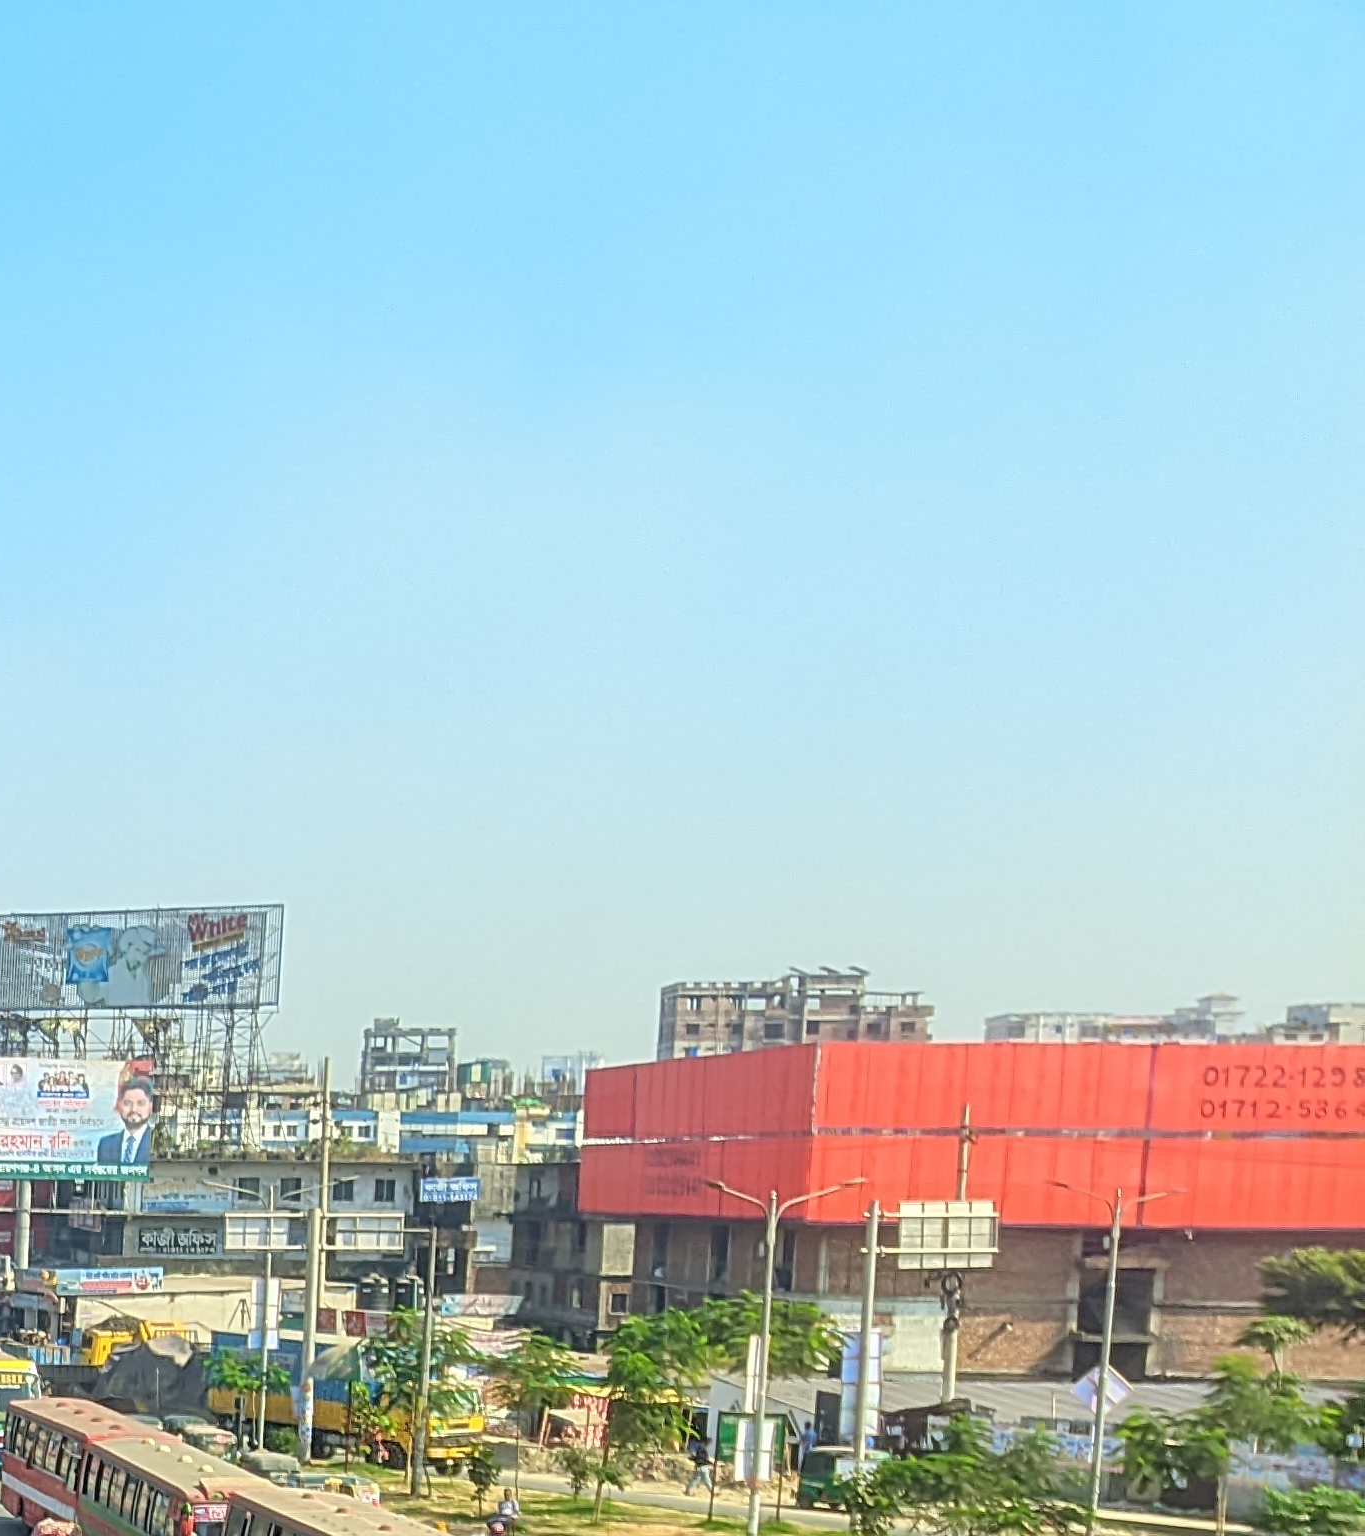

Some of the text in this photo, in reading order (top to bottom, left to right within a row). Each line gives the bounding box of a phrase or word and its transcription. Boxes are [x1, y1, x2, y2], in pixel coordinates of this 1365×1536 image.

[0, 1133, 43, 1149] রহমান
[141, 1227, 218, 1247] কাজী অফিস
